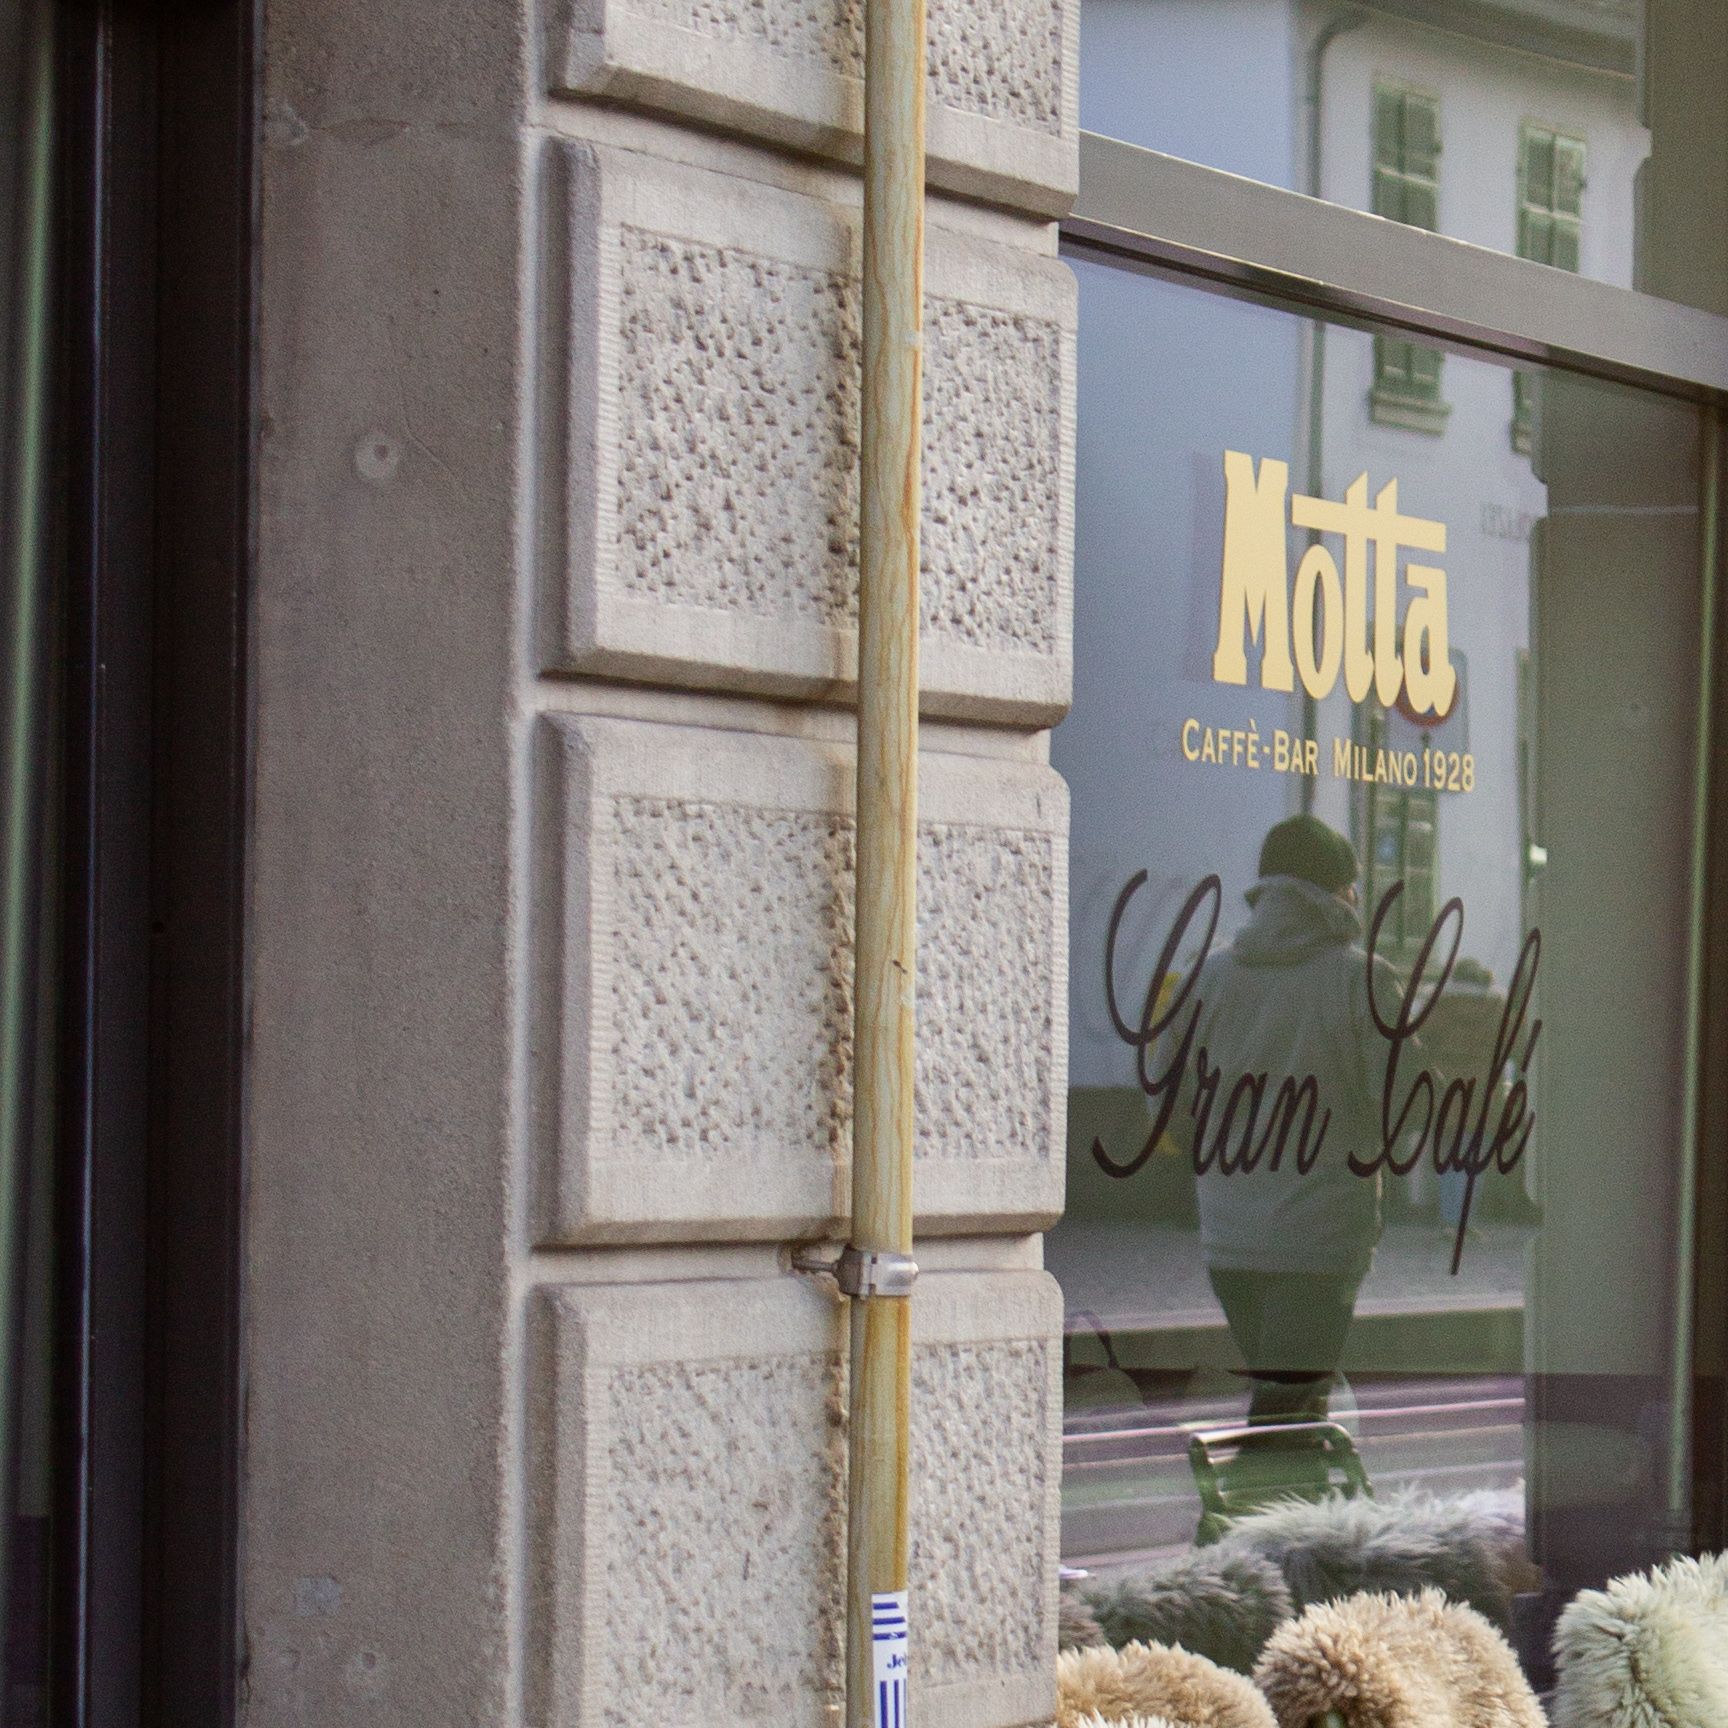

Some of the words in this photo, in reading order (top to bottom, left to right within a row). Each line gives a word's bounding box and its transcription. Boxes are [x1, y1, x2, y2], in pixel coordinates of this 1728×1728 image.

[1212, 449, 1457, 717] Motta
[1332, 737, 1418, 786] MILANO
[1422, 747, 1476, 793] 1928
[1091, 868, 1331, 1178] Gran
[1347, 879, 1543, 1276] Café
